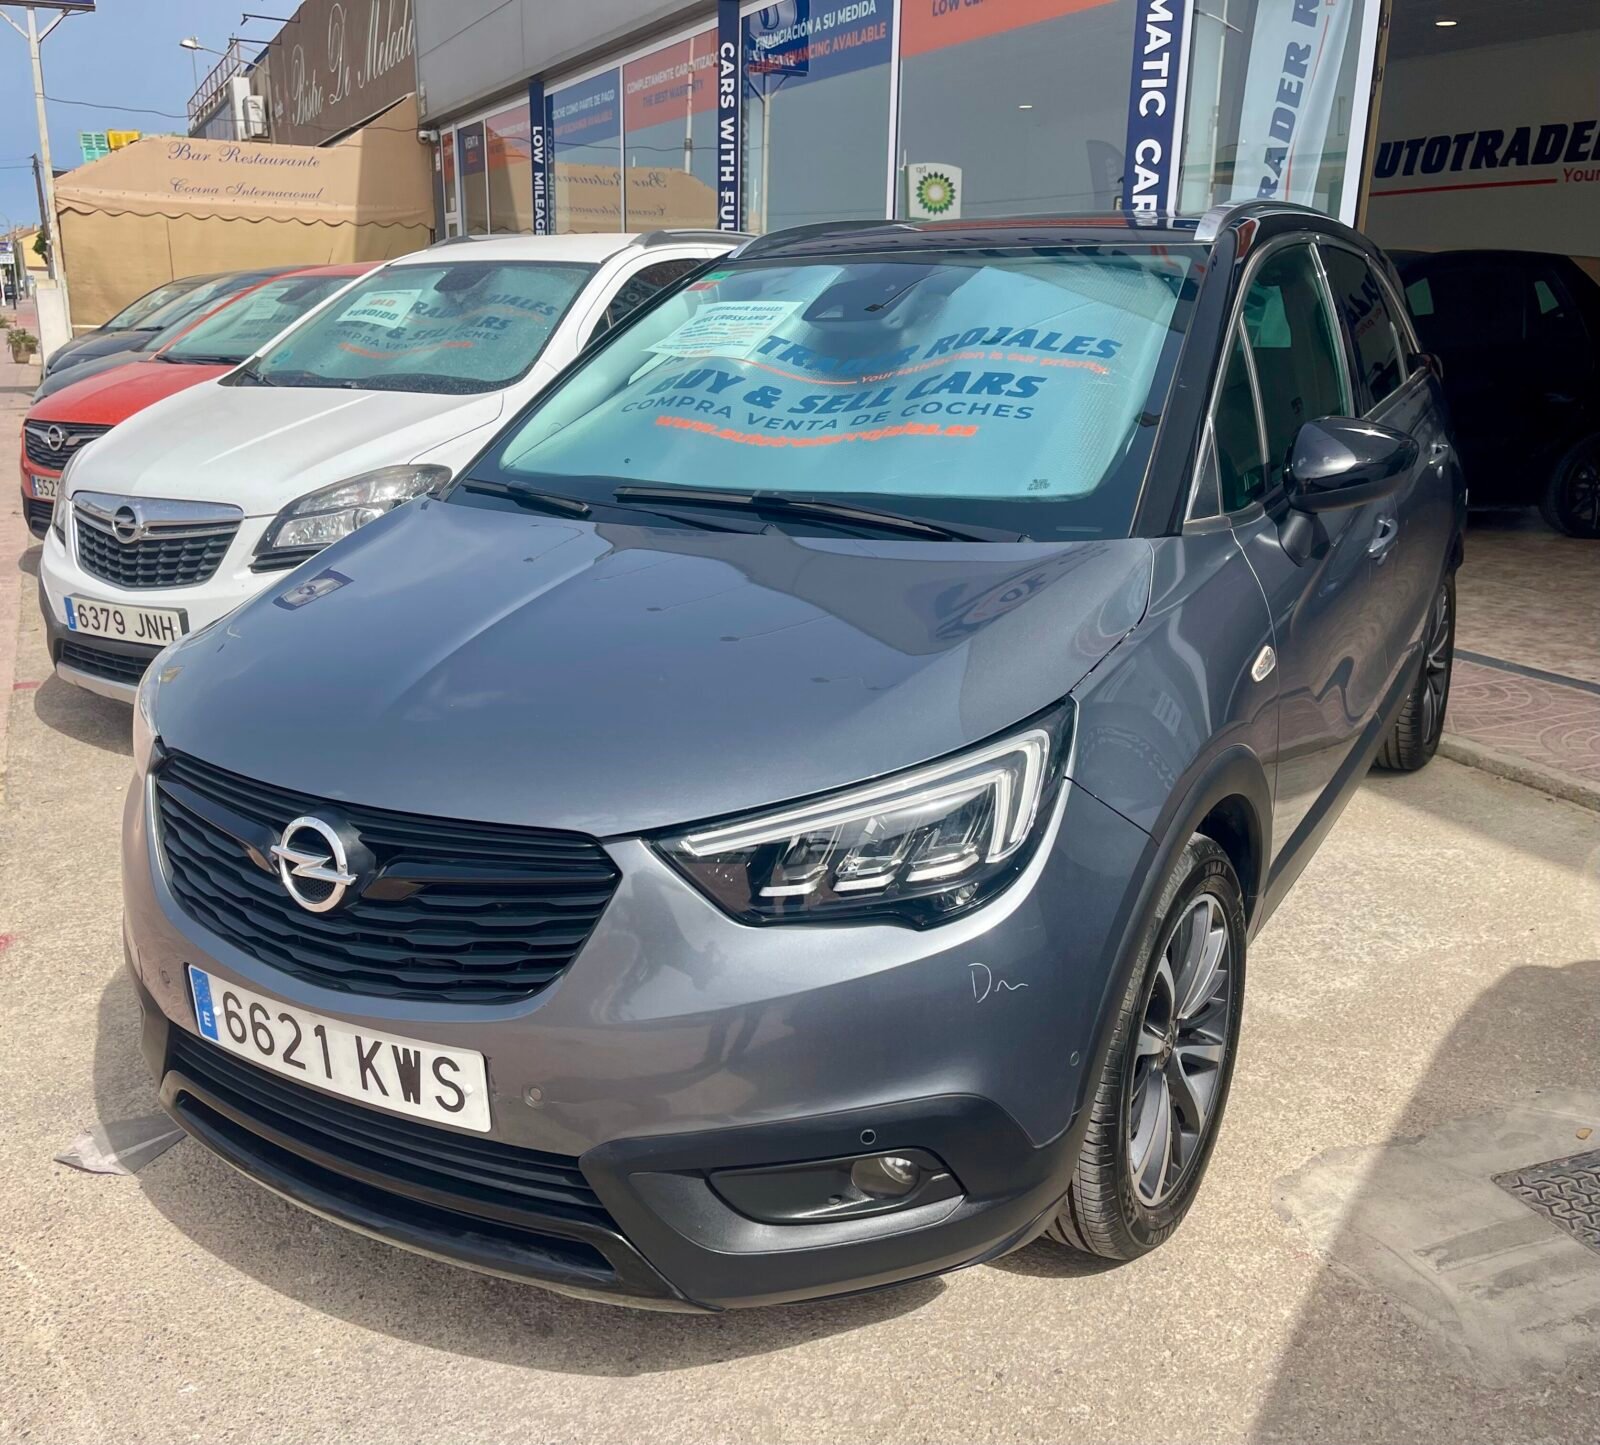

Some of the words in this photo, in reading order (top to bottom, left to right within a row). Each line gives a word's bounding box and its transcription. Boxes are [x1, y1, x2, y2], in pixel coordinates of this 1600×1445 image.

[814, 20, 822, 32] A
[823, 12, 836, 29] SU
[837, 0, 877, 25] MEDIDA
[327, 3, 351, 104] De
[832, 22, 887, 52] AVAILABLE
[720, 42, 735, 109] CARS
[1138, 0, 1173, 117] MATIC
[167, 141, 210, 161] Bar
[218, 144, 320, 168] Restaurante
[533, 127, 544, 164] LOW
[720, 117, 735, 182] WITH
[1374, 120, 1600, 179] UTOTRADE
[170, 177, 219, 194] Cocina
[226, 182, 324, 200] Internacional
[924, 326, 1123, 360] ROJALES
[645, 369, 747, 396] BUY
[743, 385, 783, 409] &
[787, 386, 898, 414] SELL
[905, 371, 1047, 400] CARS
[862, 371, 893, 383] Your
[621, 396, 732, 419] COMPRA
[748, 412, 837, 430] VENTA
[849, 410, 891, 426] DE
[901, 401, 1035, 419] COCHES
[77, 604, 126, 635] 6379
[135, 613, 175, 641] JNH
[202, 1010, 212, 1028] E
[222, 991, 333, 1080] 6621
[354, 1035, 466, 1113] KWS
